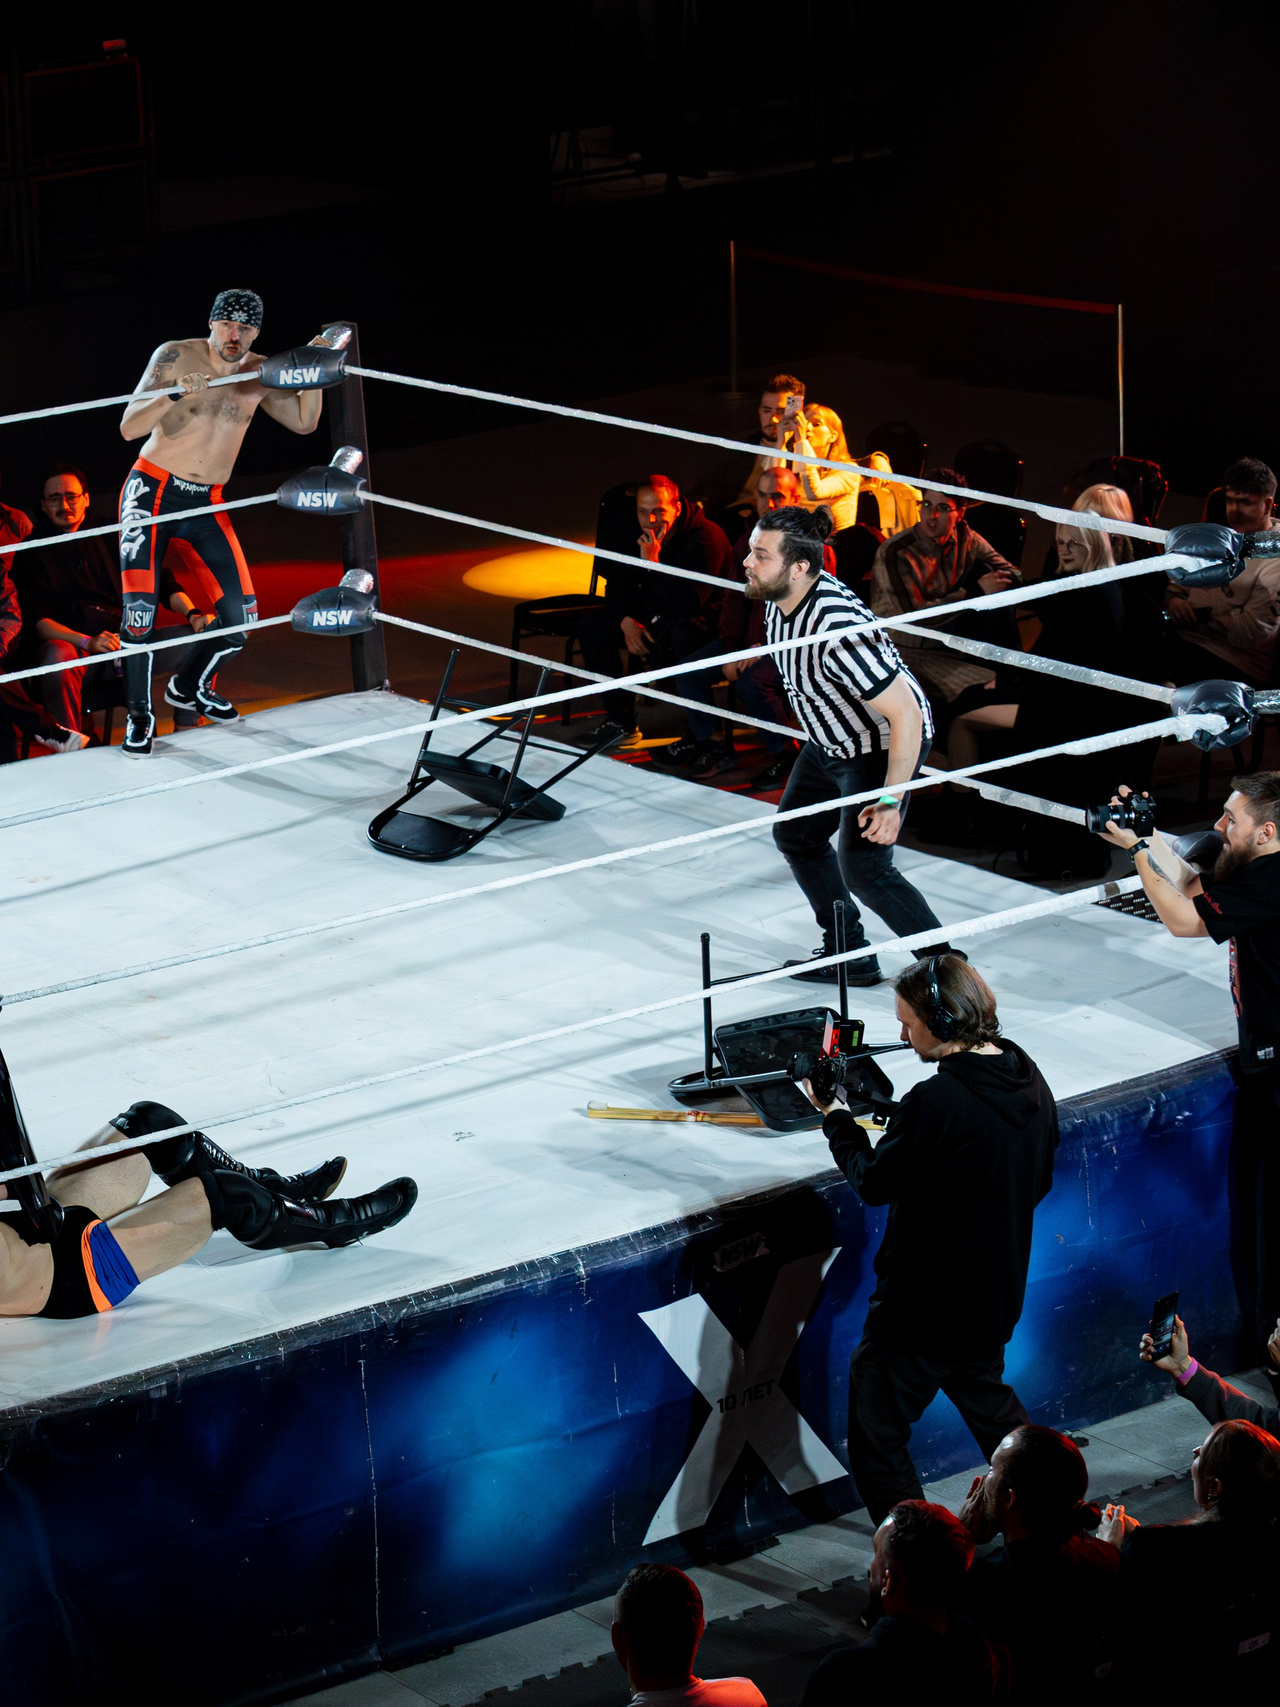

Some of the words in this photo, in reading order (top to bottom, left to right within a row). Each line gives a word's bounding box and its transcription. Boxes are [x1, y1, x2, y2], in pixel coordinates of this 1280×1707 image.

[279, 367, 321, 385] NSW
[297, 492, 338, 508] NSW
[127, 609, 152, 628] NSW
[313, 610, 353, 627] NSW
[716, 1395, 737, 1413] 10
[741, 1379, 775, 1406] ЛЕТ
